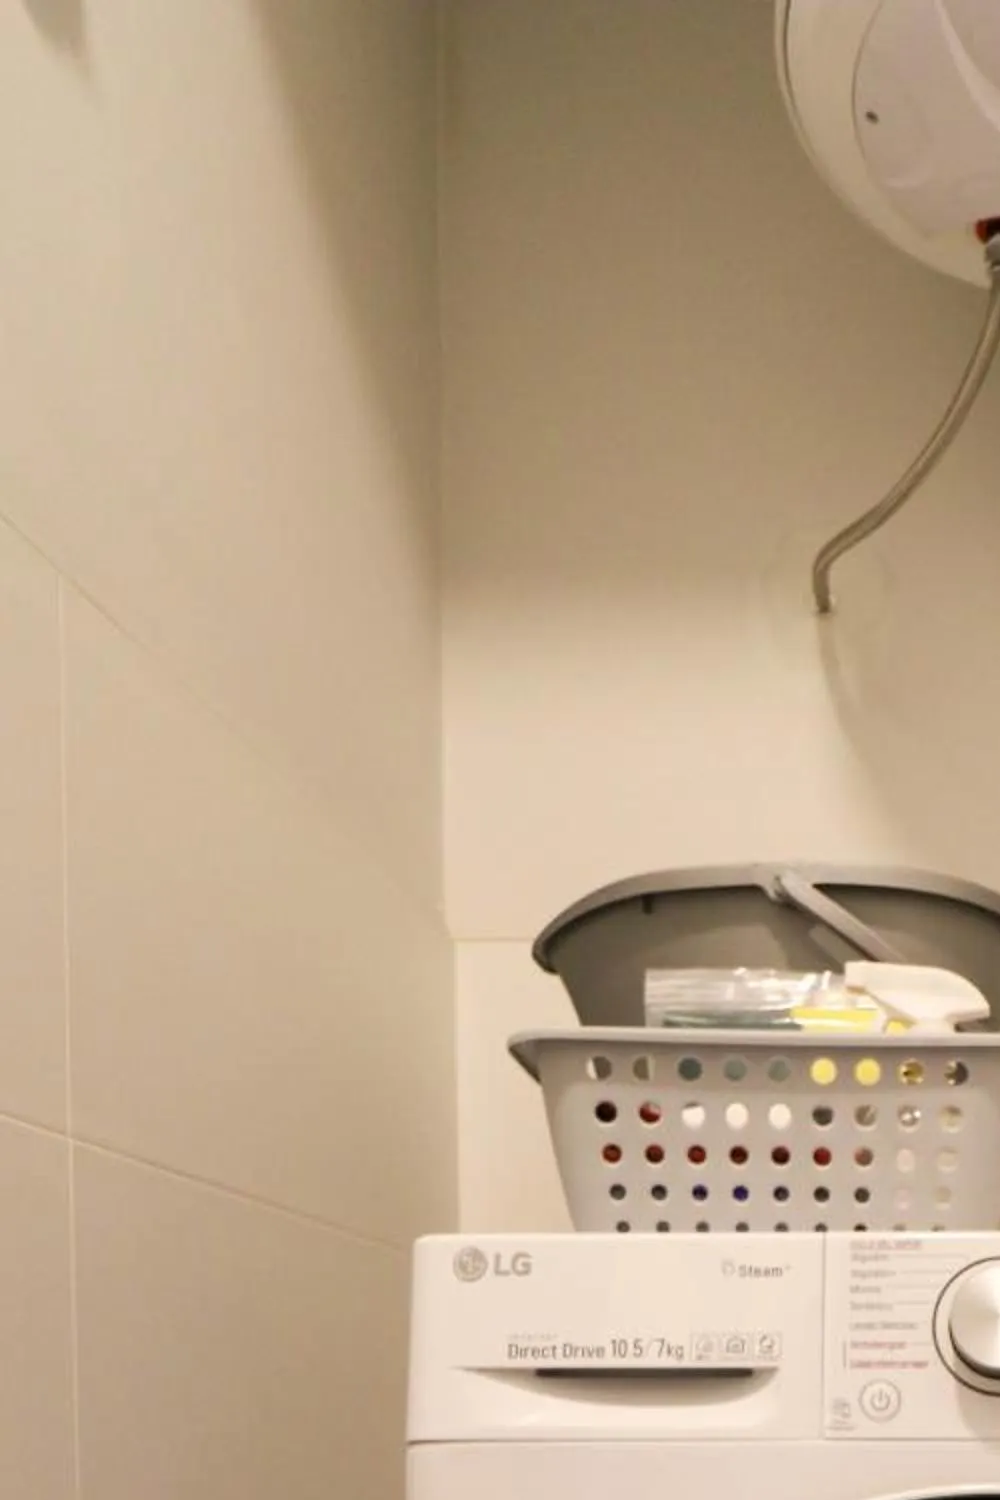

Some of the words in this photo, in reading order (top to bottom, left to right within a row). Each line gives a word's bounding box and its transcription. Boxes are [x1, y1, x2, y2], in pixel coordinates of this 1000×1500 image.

[493, 1252, 533, 1277] LG
[507, 1343, 558, 1360] Direct
[562, 1343, 606, 1360] Drive
